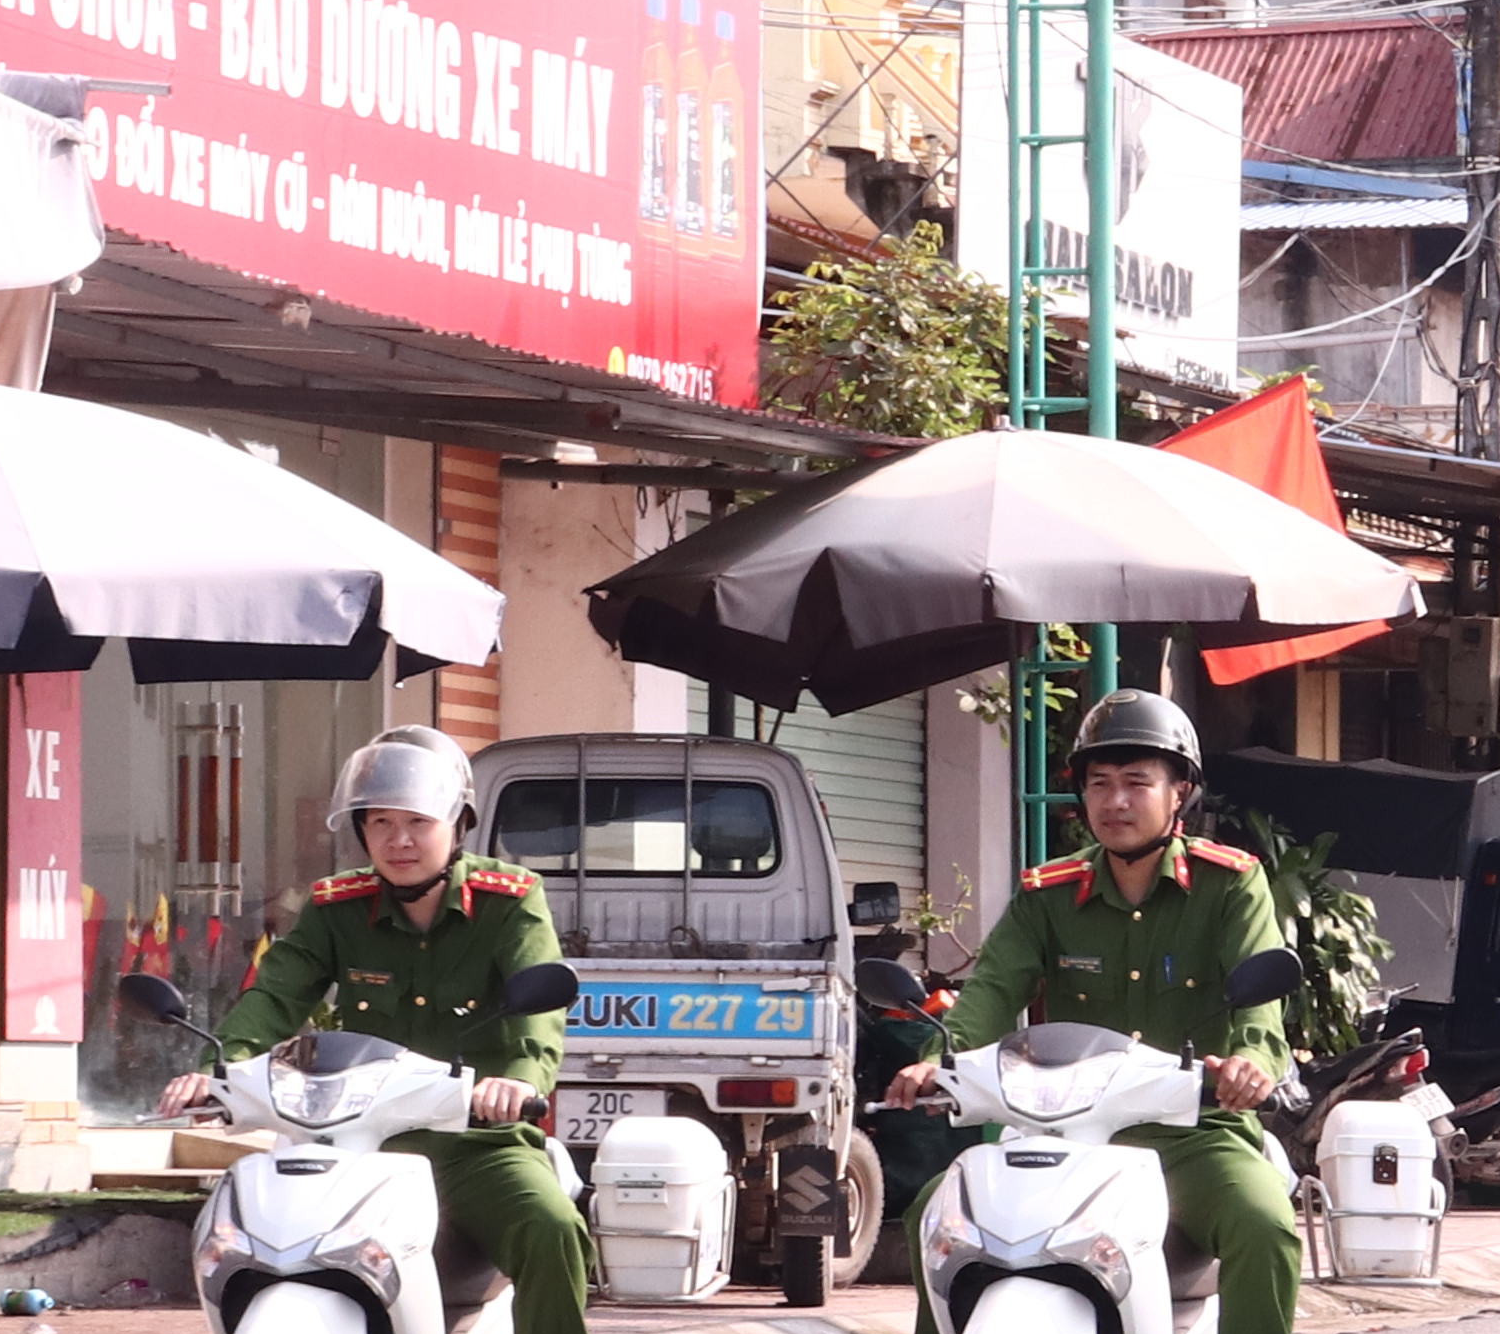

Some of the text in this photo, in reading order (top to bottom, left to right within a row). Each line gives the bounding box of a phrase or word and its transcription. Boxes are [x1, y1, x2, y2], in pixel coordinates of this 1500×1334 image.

[470, 30, 522, 155] XE
[531, 36, 614, 178] MÁY
[115, 94, 165, 197] ĐỔI
[169, 128, 205, 208] XE
[209, 133, 271, 222] MÁY
[274, 151, 308, 233] CŨ
[329, 163, 378, 251] BÁN
[454, 194, 499, 278] BÁN
[502, 199, 528, 285] LẺ
[531, 222, 574, 309] PHỤ
[577, 222, 633, 307] TÙNG
[25, 728, 61, 800] XE
[19, 853, 67, 940] MÁY
[566, 994, 806, 1032] ZUKI 227 29
[587, 1092, 634, 1115] 20C
[567, 1118, 613, 1141] 227
[1009, 1155, 1057, 1164] HONDA
[781, 1215, 833, 1224] SUZUKI
